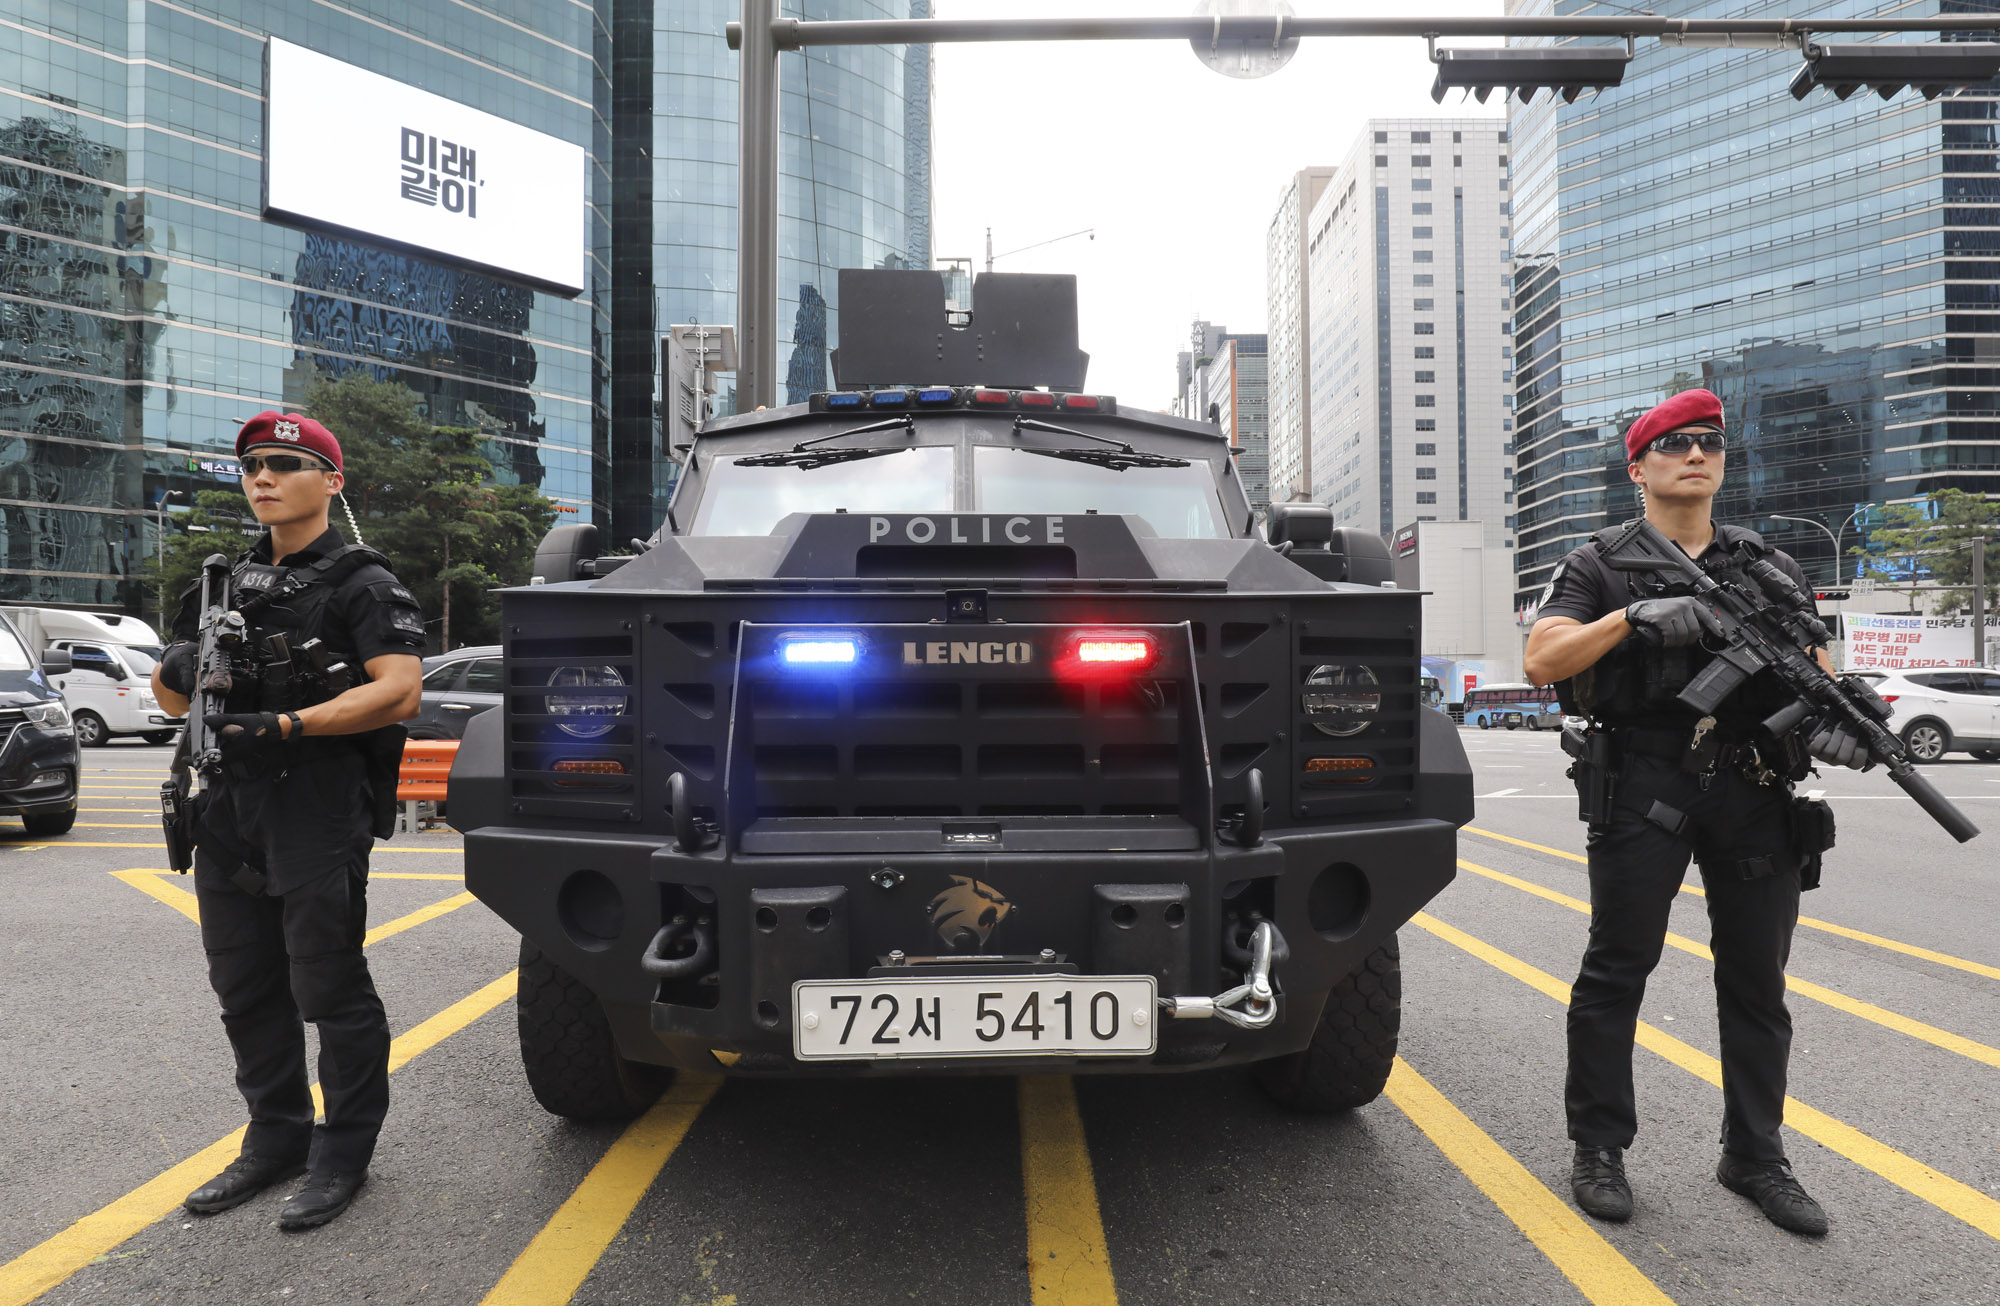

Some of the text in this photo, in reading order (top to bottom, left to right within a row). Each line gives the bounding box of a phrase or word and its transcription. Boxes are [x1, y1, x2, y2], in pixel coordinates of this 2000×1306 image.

[400, 126, 485, 187] 미래,
[400, 163, 476, 219] 같이
[869, 516, 1065, 544] POLICE
[240, 572, 273, 589] A314
[1847, 616, 1922, 629] 괴담선동전문
[1926, 618, 1967, 629] 민주당
[1852, 630, 1923, 644] 광우병 괴담
[903, 641, 1032, 664] LENCO
[1852, 643, 1909, 656] 사드 괴담
[1853, 656, 1904, 668] 후쿠시마
[830, 990, 1120, 1045] 72서 5410
